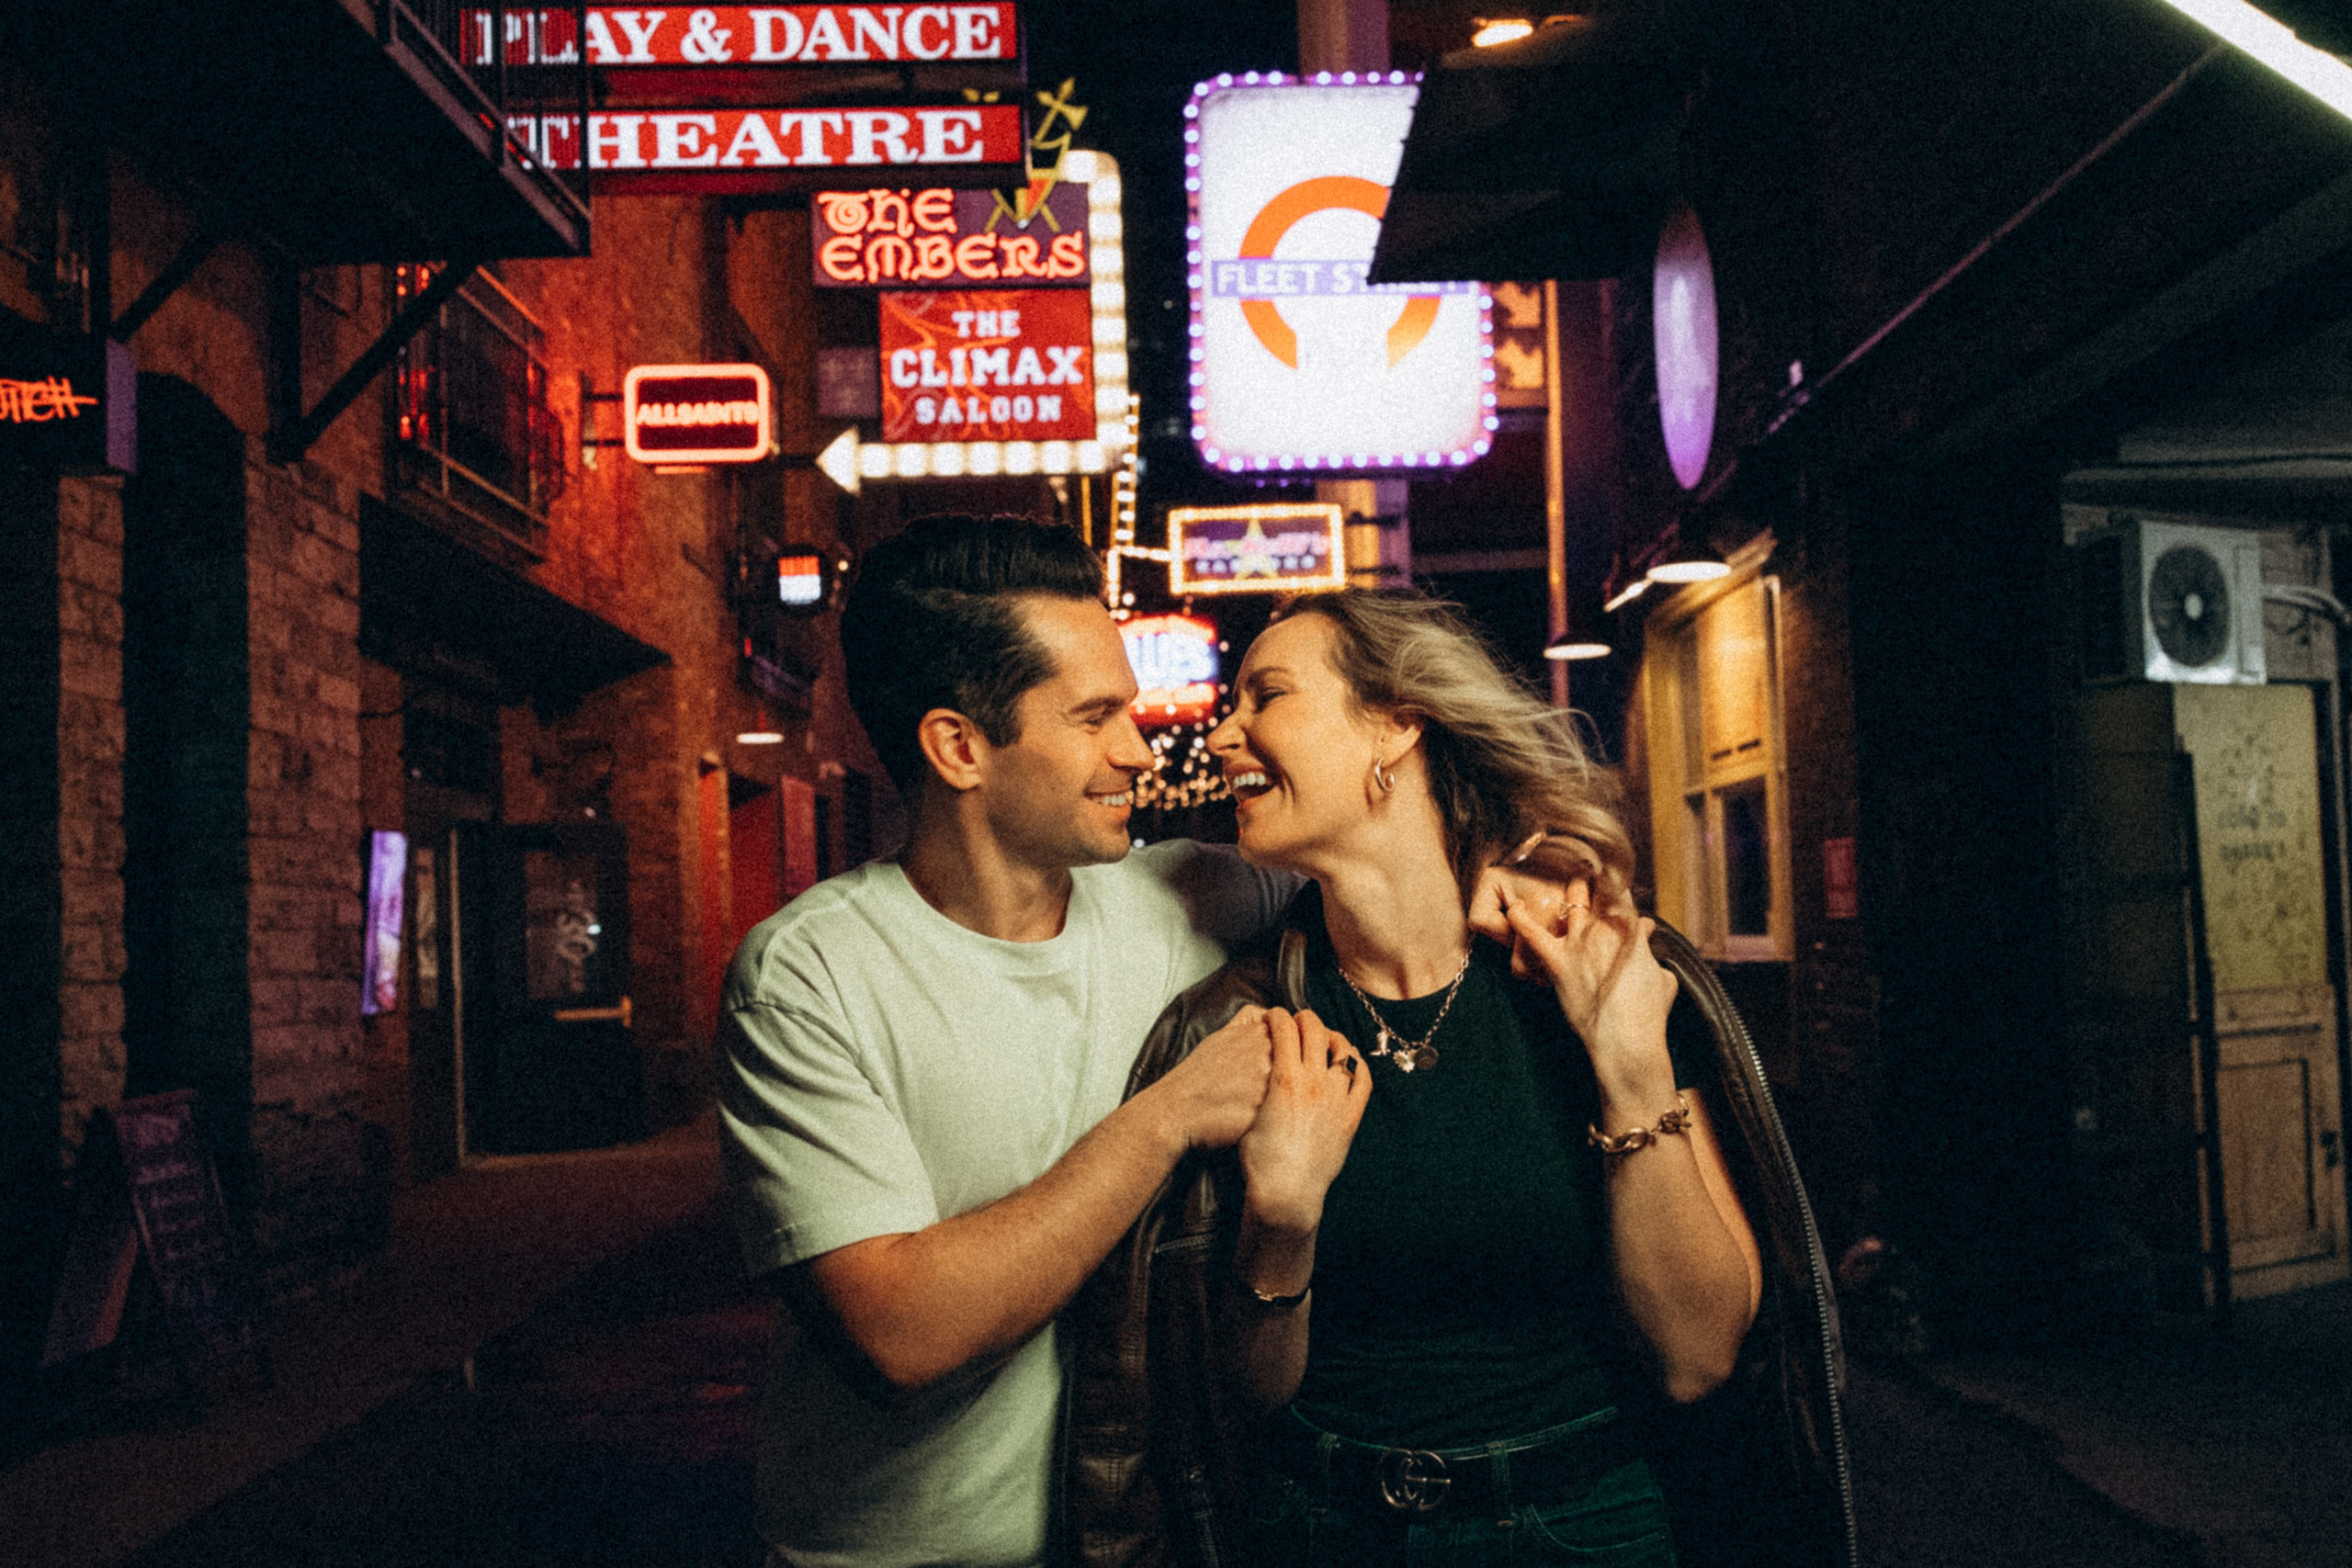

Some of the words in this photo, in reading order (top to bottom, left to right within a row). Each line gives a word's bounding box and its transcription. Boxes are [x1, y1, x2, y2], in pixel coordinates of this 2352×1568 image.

[475, 10, 667, 64] PLAY
[680, 8, 733, 63] &
[748, 6, 1001, 62] DANCE
[507, 109, 984, 169] THEATRE
[820, 231, 1087, 283] EMBERS
[1217, 263, 1323, 293] FLEET
[951, 310, 1022, 338] THE
[889, 345, 1085, 389] CLIMAX
[914, 394, 1063, 425] SALOON
